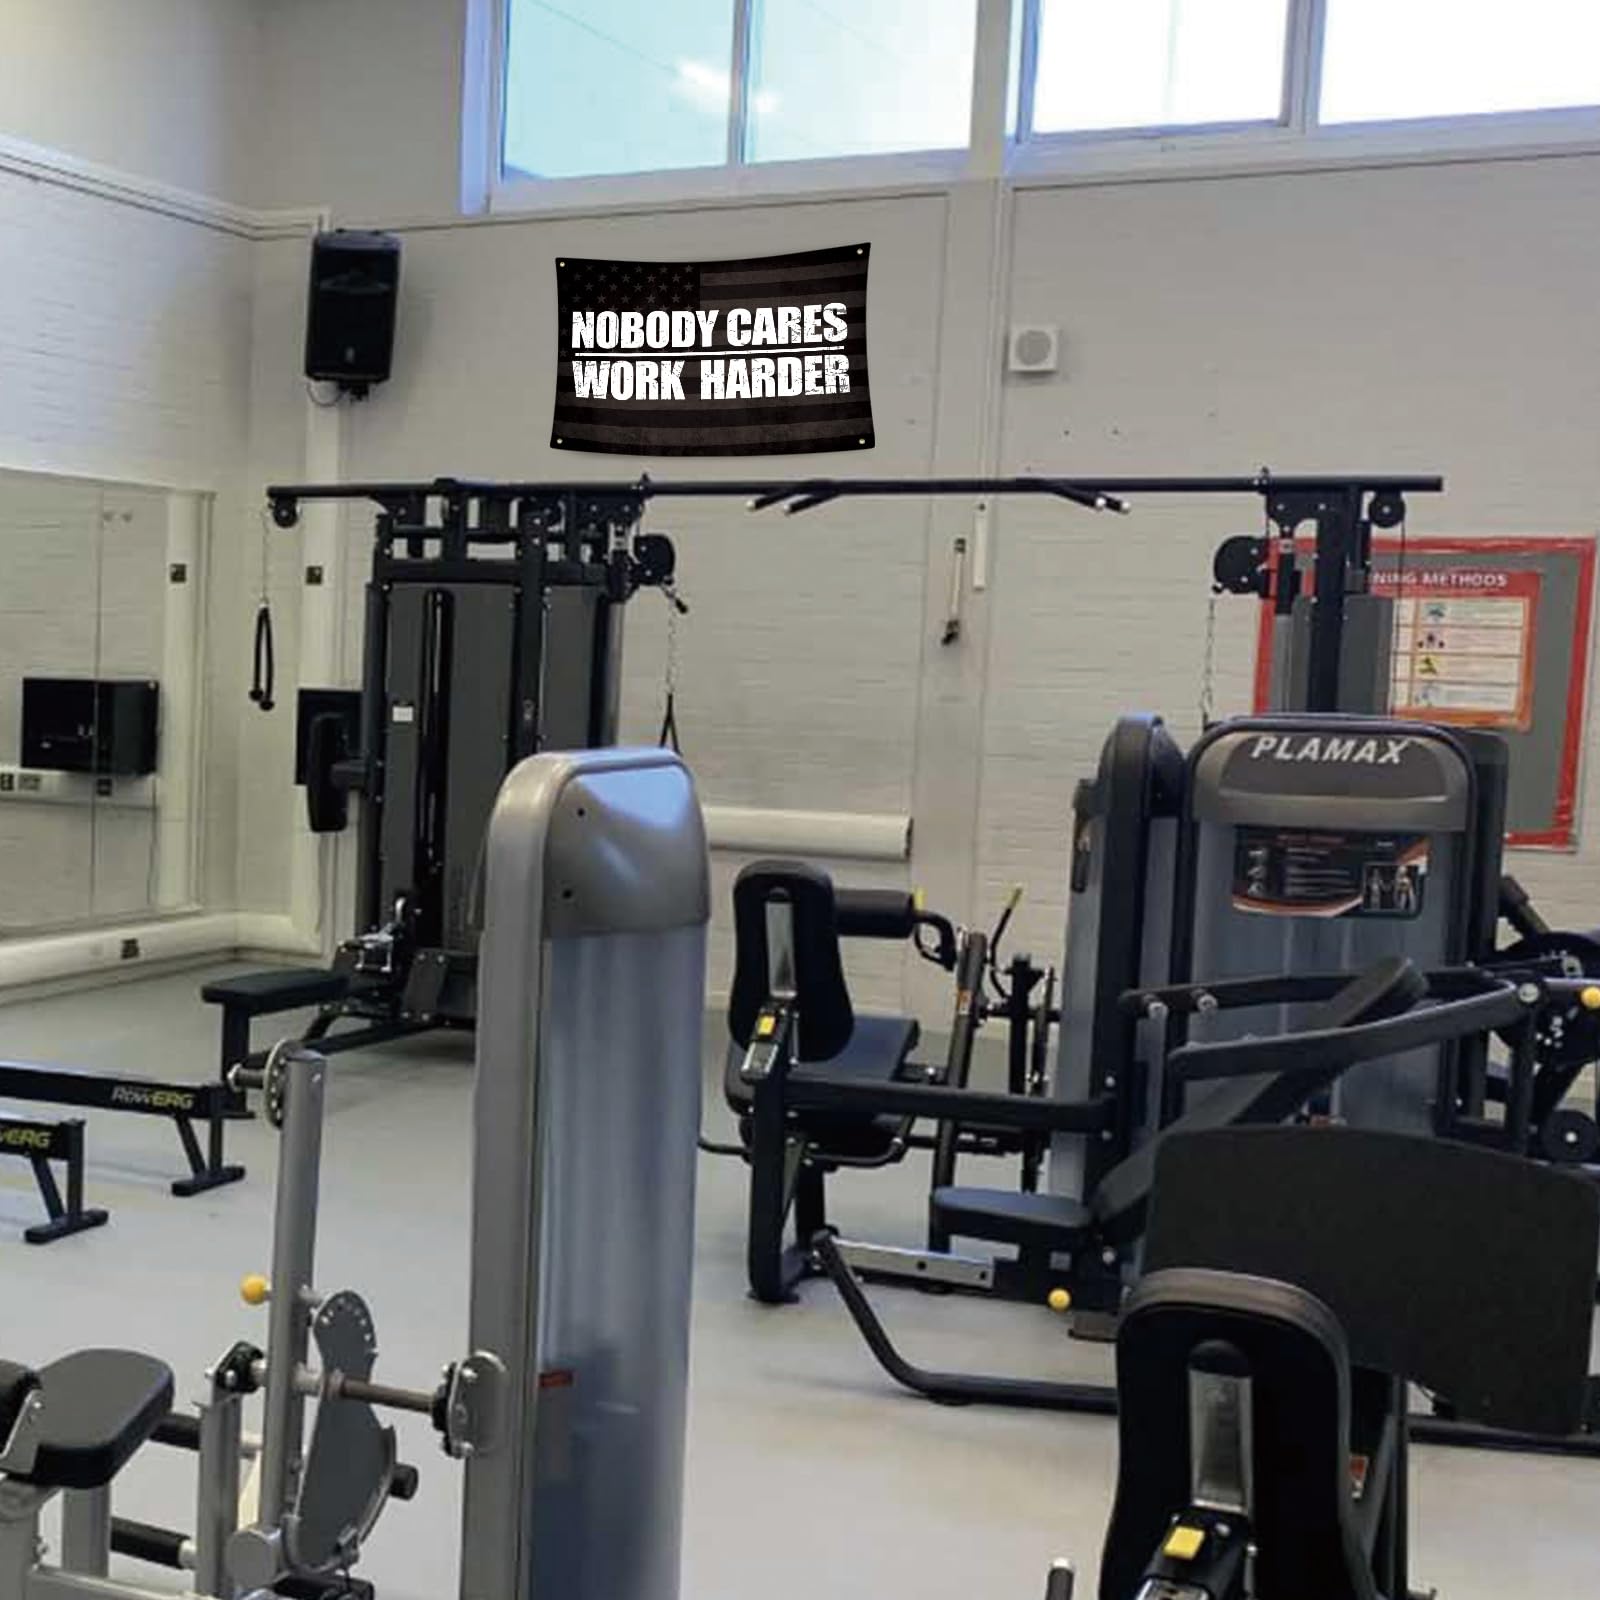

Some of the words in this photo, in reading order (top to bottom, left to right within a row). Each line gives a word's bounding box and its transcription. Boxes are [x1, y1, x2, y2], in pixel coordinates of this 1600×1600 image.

[571, 310, 719, 349] NOBODY
[726, 302, 848, 346] CARES
[571, 361, 686, 401] WORK
[700, 354, 851, 400] HARDER
[1372, 571, 1417, 586] NING
[1251, 736, 1409, 765] PLAMAX
[0, 1129, 51, 1149] ERG
